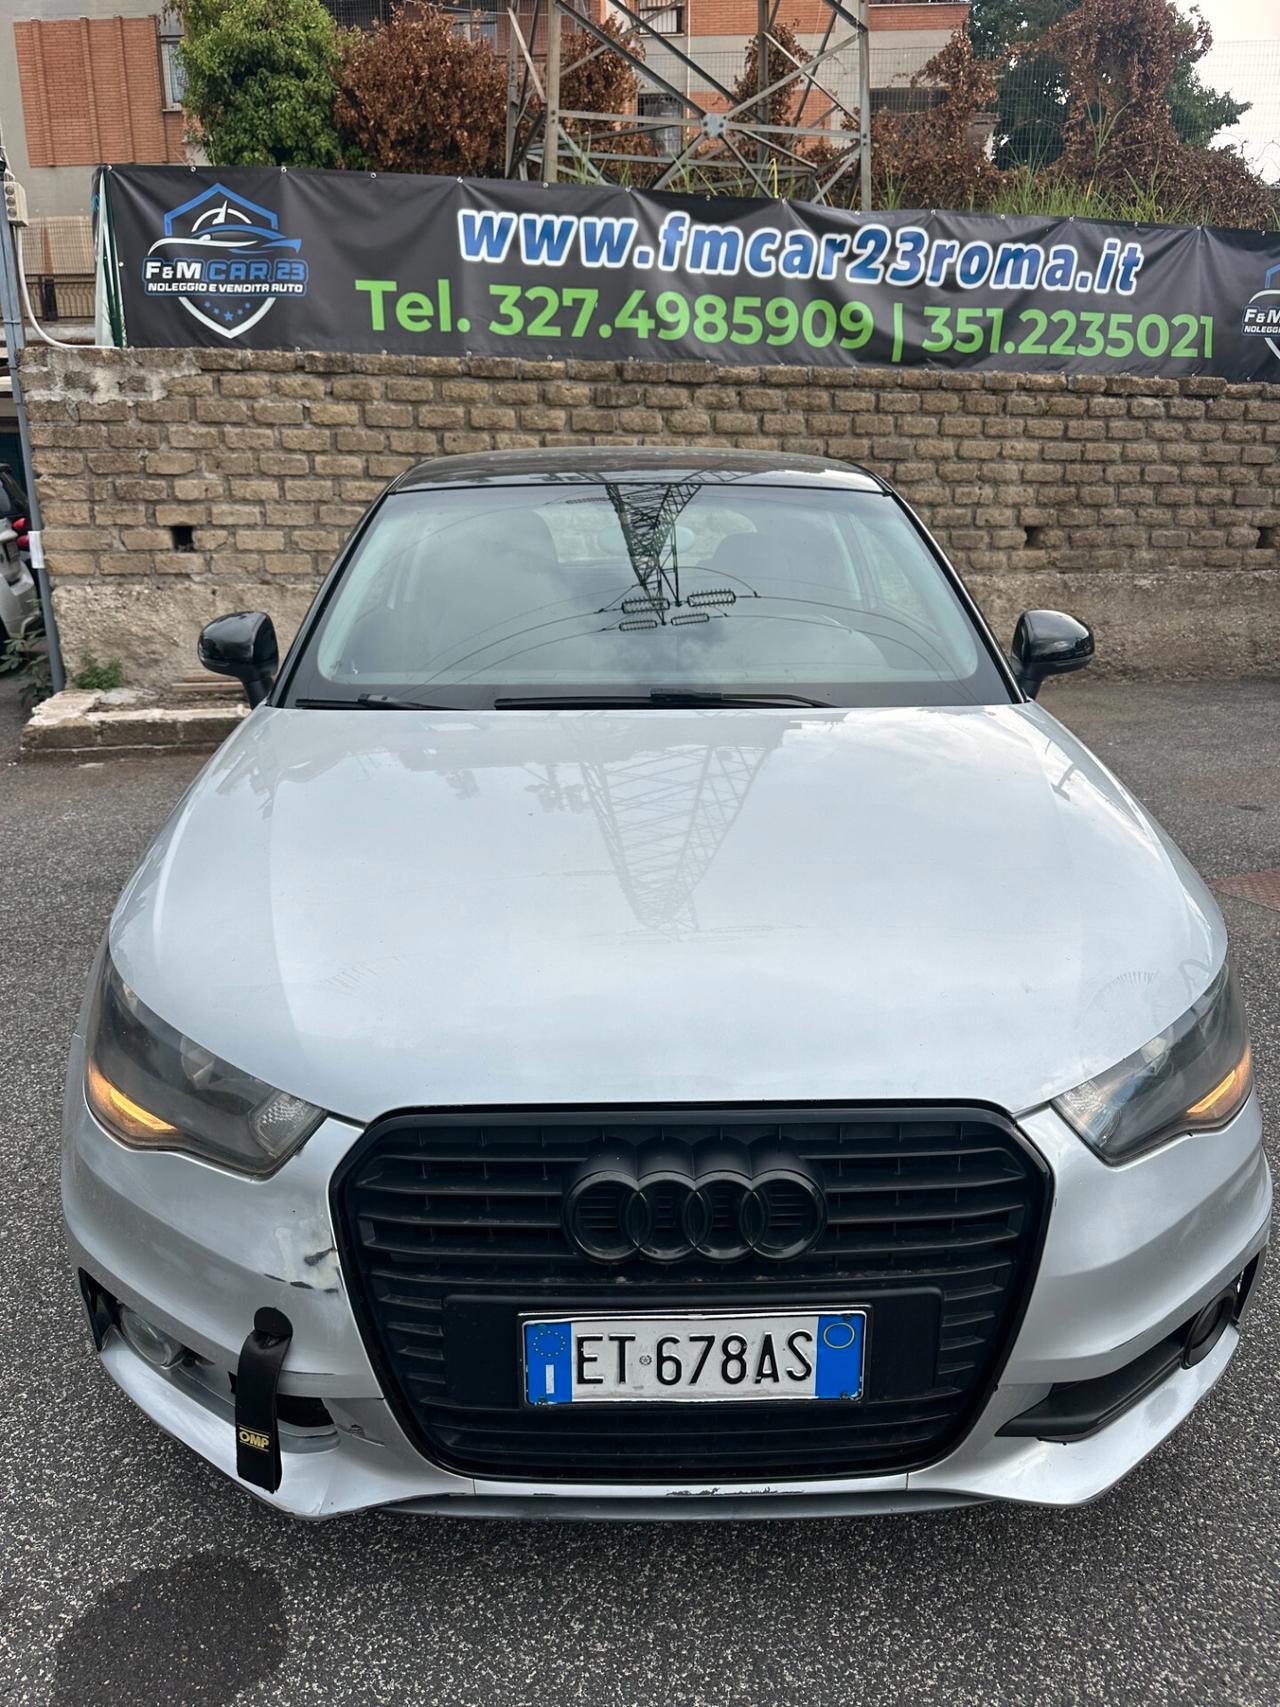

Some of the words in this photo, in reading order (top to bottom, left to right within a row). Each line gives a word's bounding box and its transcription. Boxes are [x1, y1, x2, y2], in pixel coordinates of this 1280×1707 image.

[456, 209, 1145, 295] www.fmcar23roma.it
[145, 261, 202, 279] F&M
[209, 262, 268, 280] CAR
[276, 262, 305, 280] 23
[147, 282, 207, 292] NOLEGGIO
[208, 283, 218, 292] E
[218, 283, 269, 293] VENDITA
[271, 283, 304, 293] AUTO
[354, 279, 471, 333] Tel.
[488, 284, 874, 349] 327.4985909
[921, 305, 1214, 359] 351.2235021
[576, 1333, 637, 1385] ET
[239, 1431, 269, 1448] OMP
